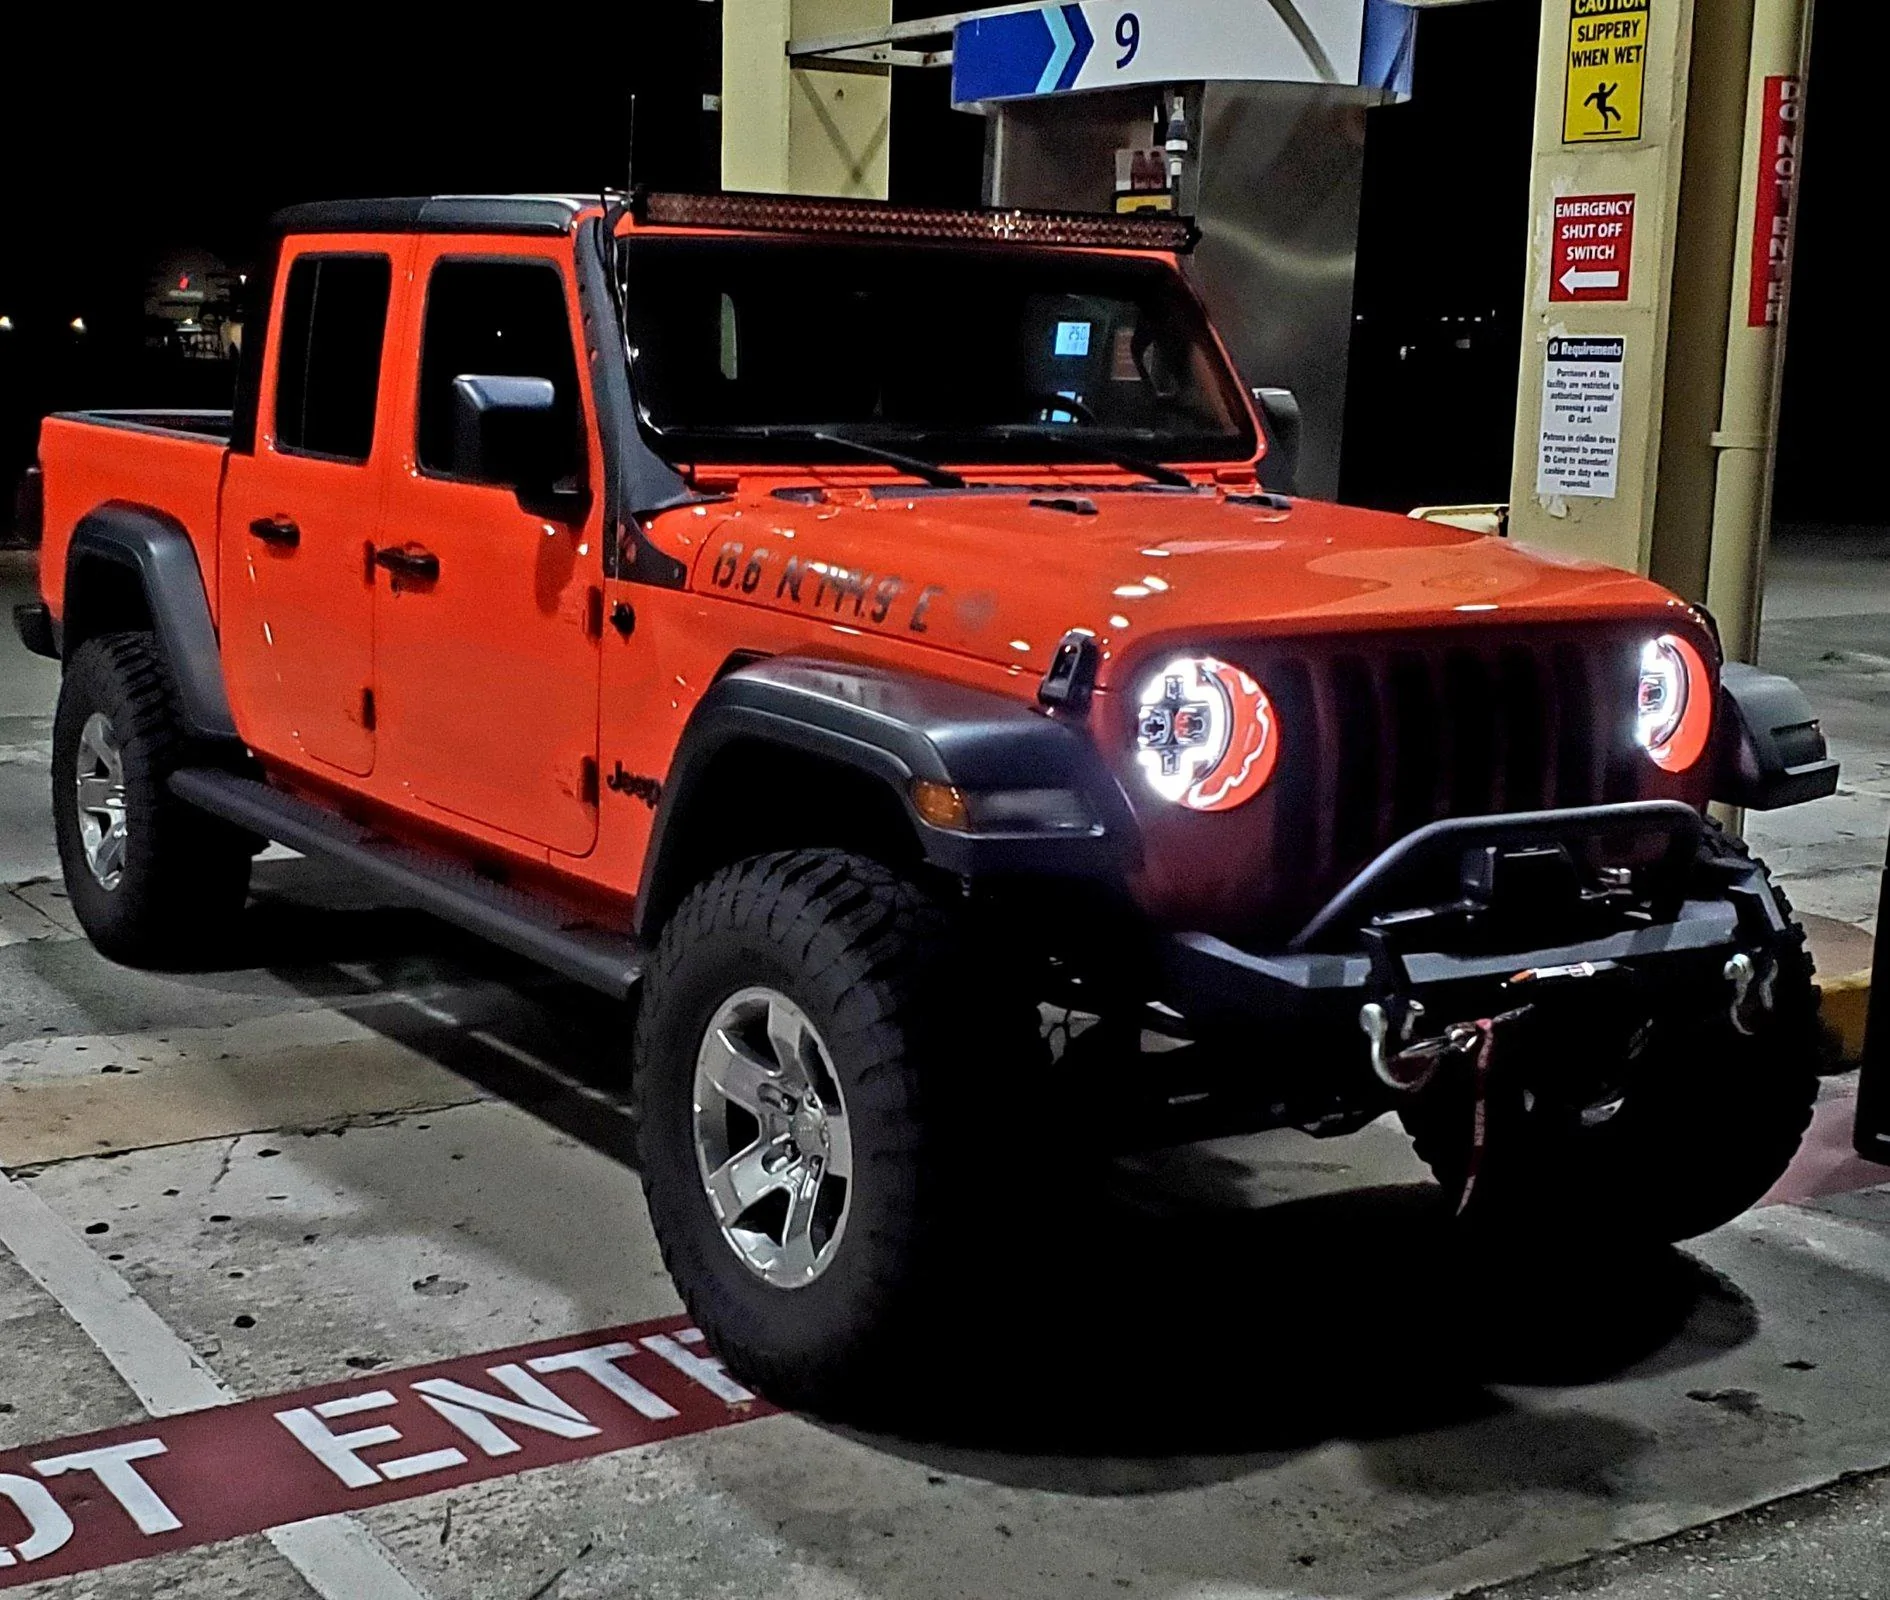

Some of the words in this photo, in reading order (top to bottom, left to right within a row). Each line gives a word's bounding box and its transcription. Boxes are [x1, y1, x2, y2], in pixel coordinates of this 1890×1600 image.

[1115, 13, 1140, 70] 9
[1577, 19, 1641, 43] SLIPPERY
[1571, 48, 1609, 68] WHEN
[1614, 45, 1643, 64] WET
[1779, 80, 1800, 121] DO
[1775, 134, 1796, 200] NOT
[1555, 200, 1633, 218] EMERGENCY
[1561, 223, 1596, 240] SHUT
[1597, 222, 1623, 238] OFF
[1566, 244, 1615, 261] SWITCH
[1561, 341, 1622, 358] Requirements
[606, 760, 661, 810] Jeep
